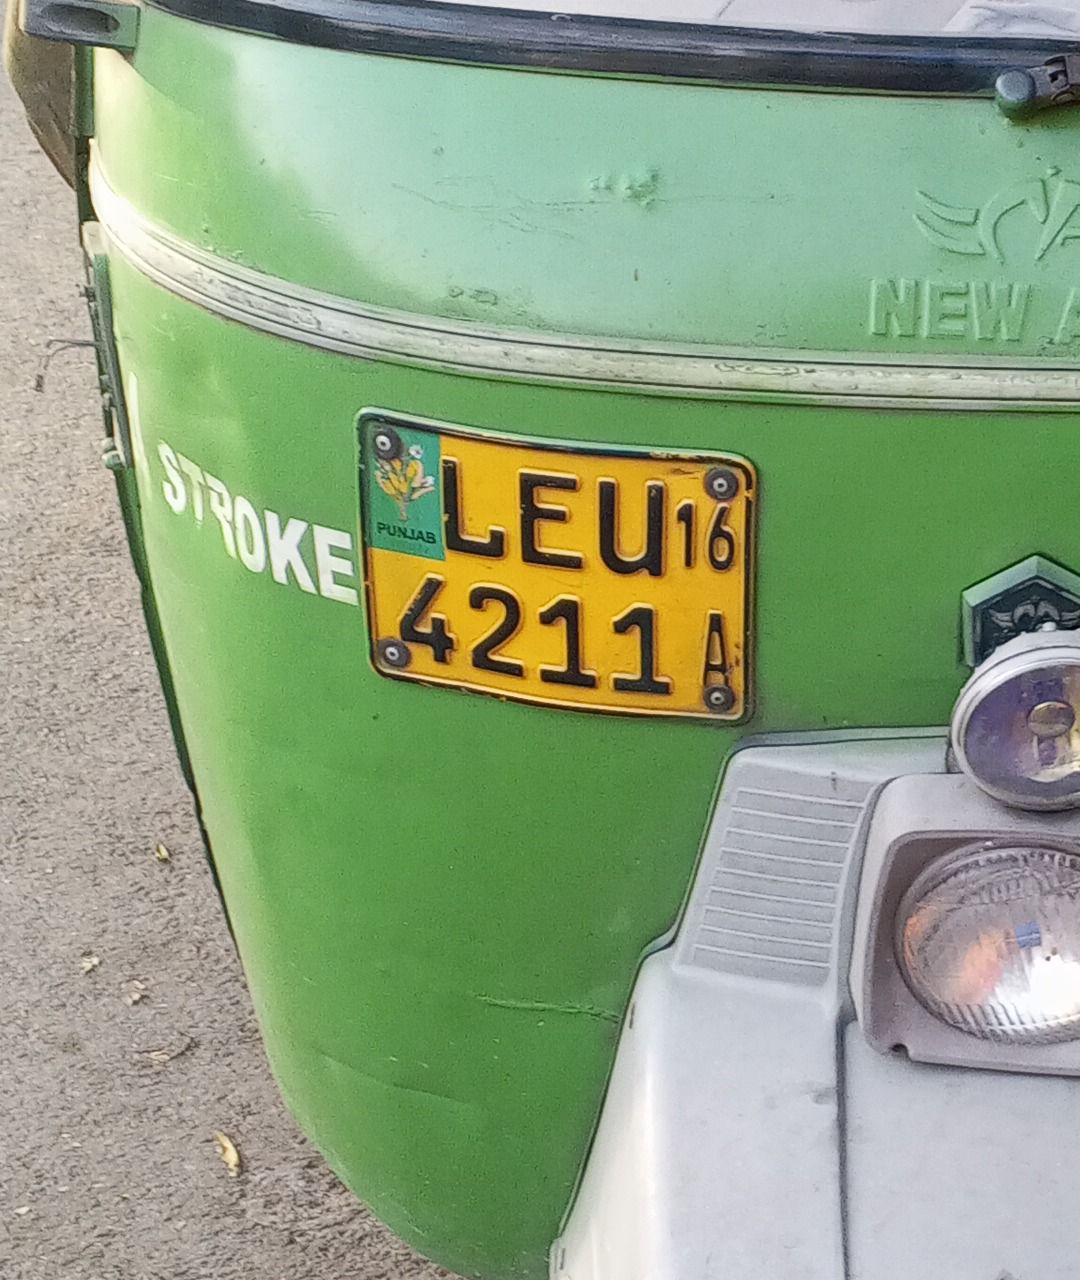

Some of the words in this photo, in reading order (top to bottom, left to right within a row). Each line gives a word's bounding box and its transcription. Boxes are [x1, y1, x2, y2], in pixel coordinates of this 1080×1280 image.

[868, 277, 1032, 342] NEW
[157, 438, 359, 607] STROKE
[376, 520, 437, 546] PUNJAB
[399, 572, 673, 696] 4211
